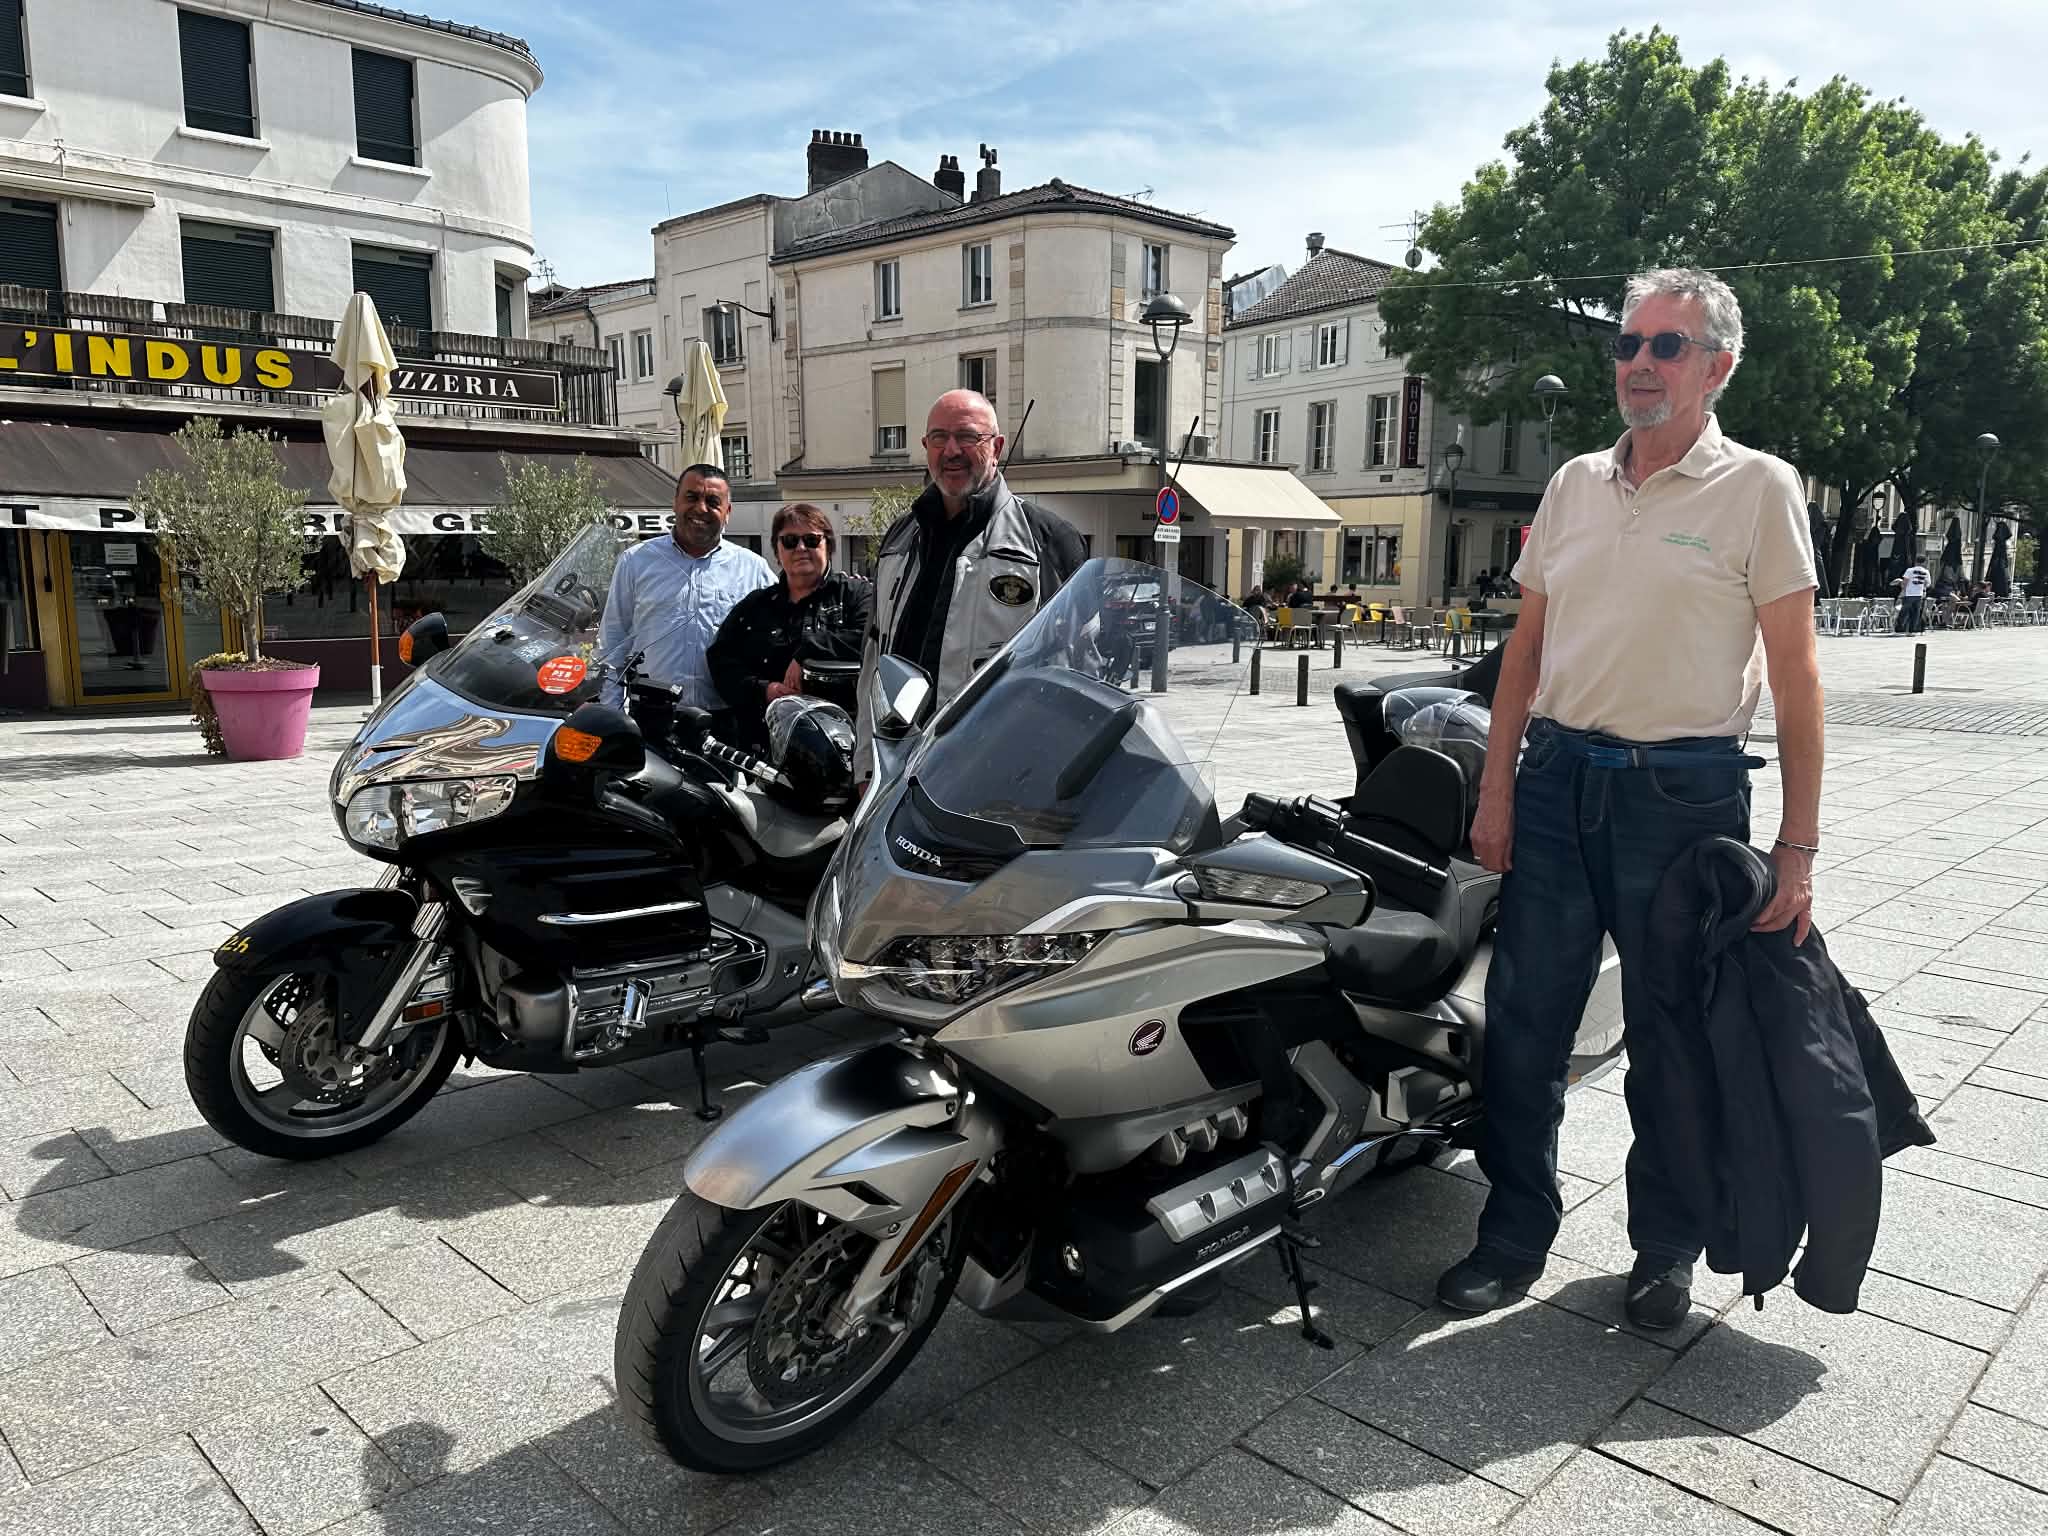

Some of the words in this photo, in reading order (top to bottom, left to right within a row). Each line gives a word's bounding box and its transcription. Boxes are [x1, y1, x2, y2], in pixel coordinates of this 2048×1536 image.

[398, 370, 520, 398] ZZERIA
[1407, 383, 1419, 460] HOTEL
[895, 835, 942, 867] HONDA
[1195, 1225, 1250, 1261] HONDA
